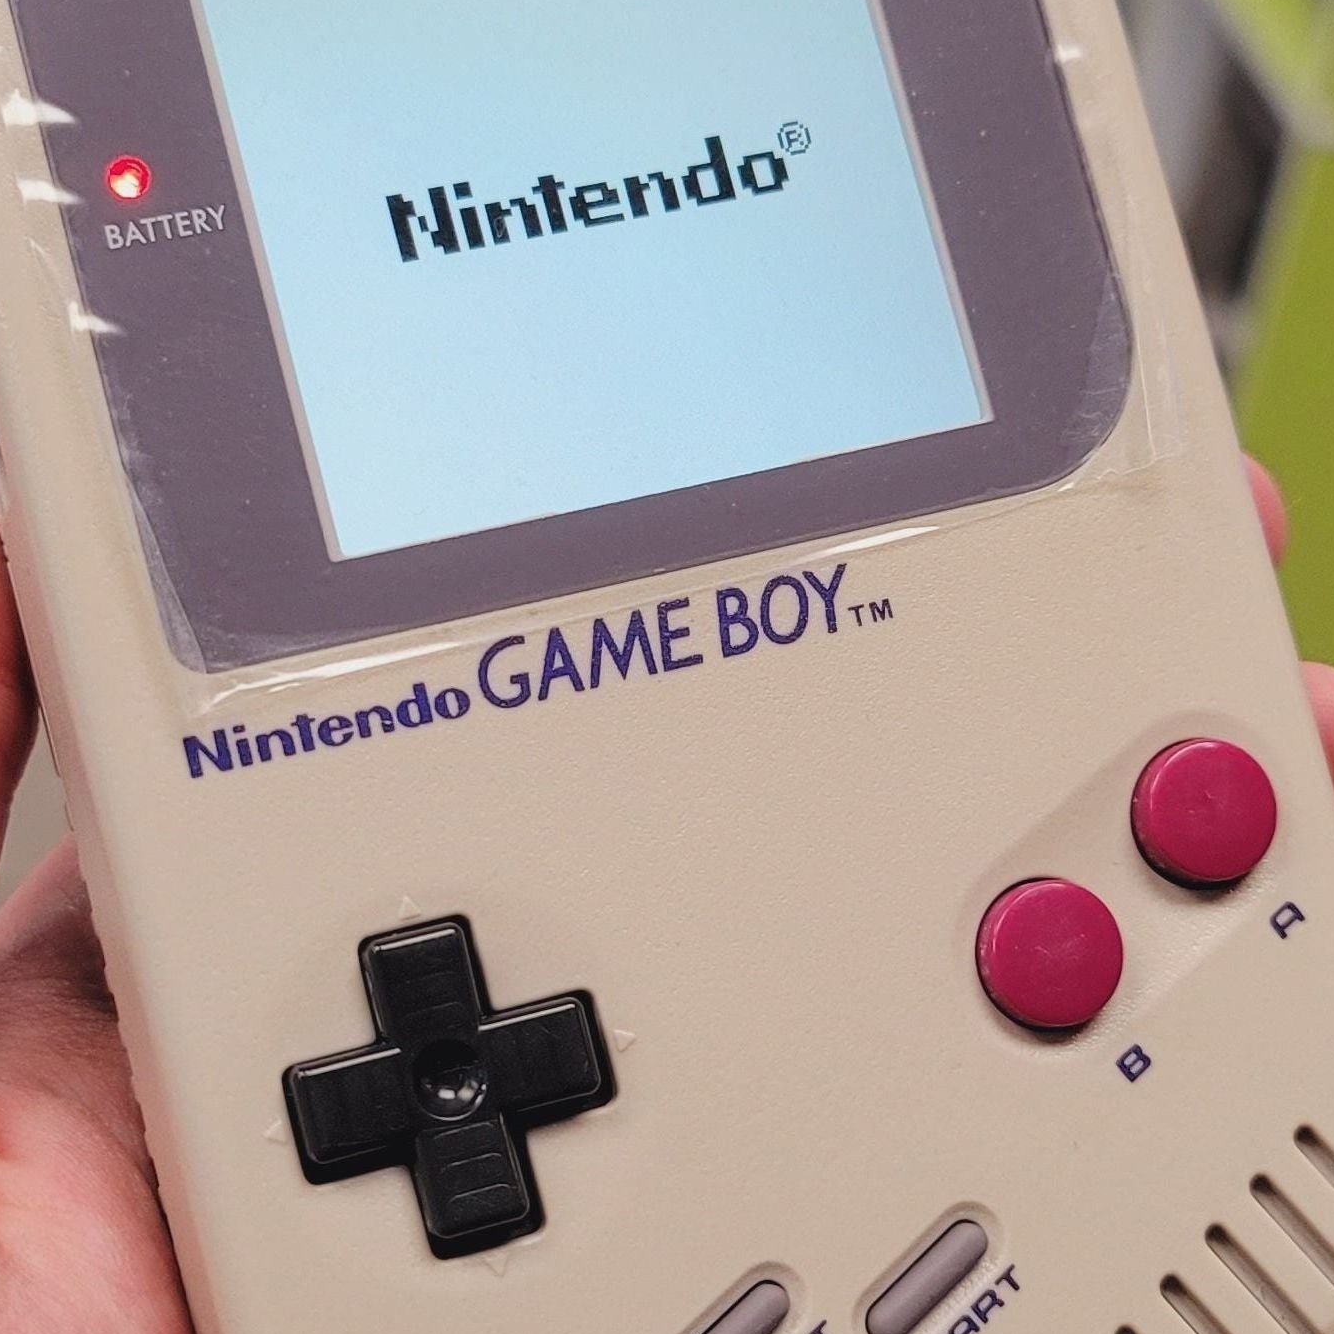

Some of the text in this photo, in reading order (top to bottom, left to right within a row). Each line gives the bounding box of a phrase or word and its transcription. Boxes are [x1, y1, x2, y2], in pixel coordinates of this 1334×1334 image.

[104, 204, 225, 250] BATTERY
[182, 682, 471, 779] Nintendo
[478, 596, 704, 709] GAME
[1270, 901, 1306, 939] A
[1116, 1043, 1152, 1083] B
